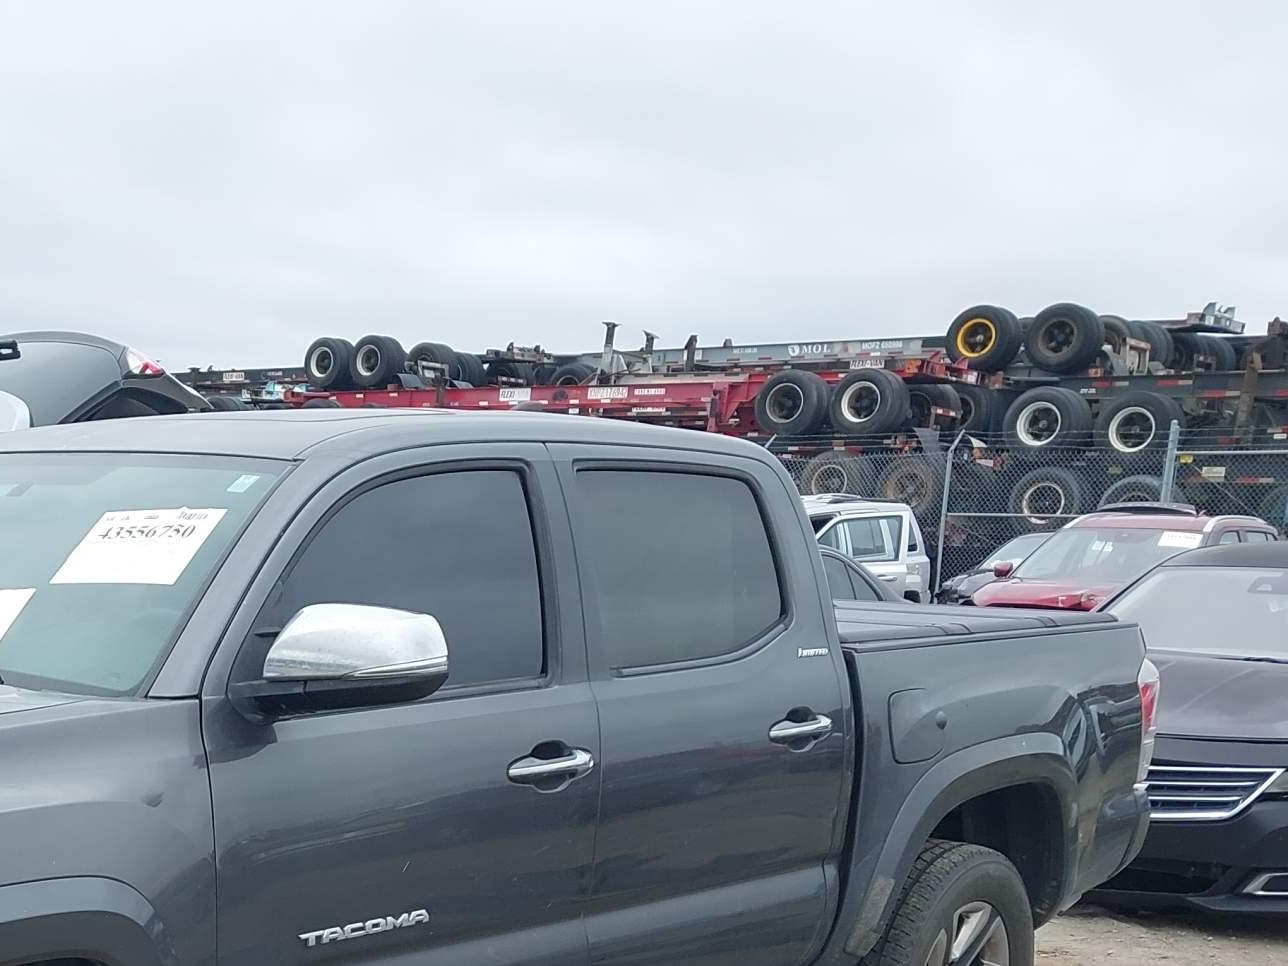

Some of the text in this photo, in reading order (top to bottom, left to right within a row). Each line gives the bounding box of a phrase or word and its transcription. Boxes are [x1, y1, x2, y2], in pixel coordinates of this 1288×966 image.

[801, 344, 831, 354] MOL
[98, 524, 196, 540] 43556750
[298, 909, 430, 946] TACOMA
